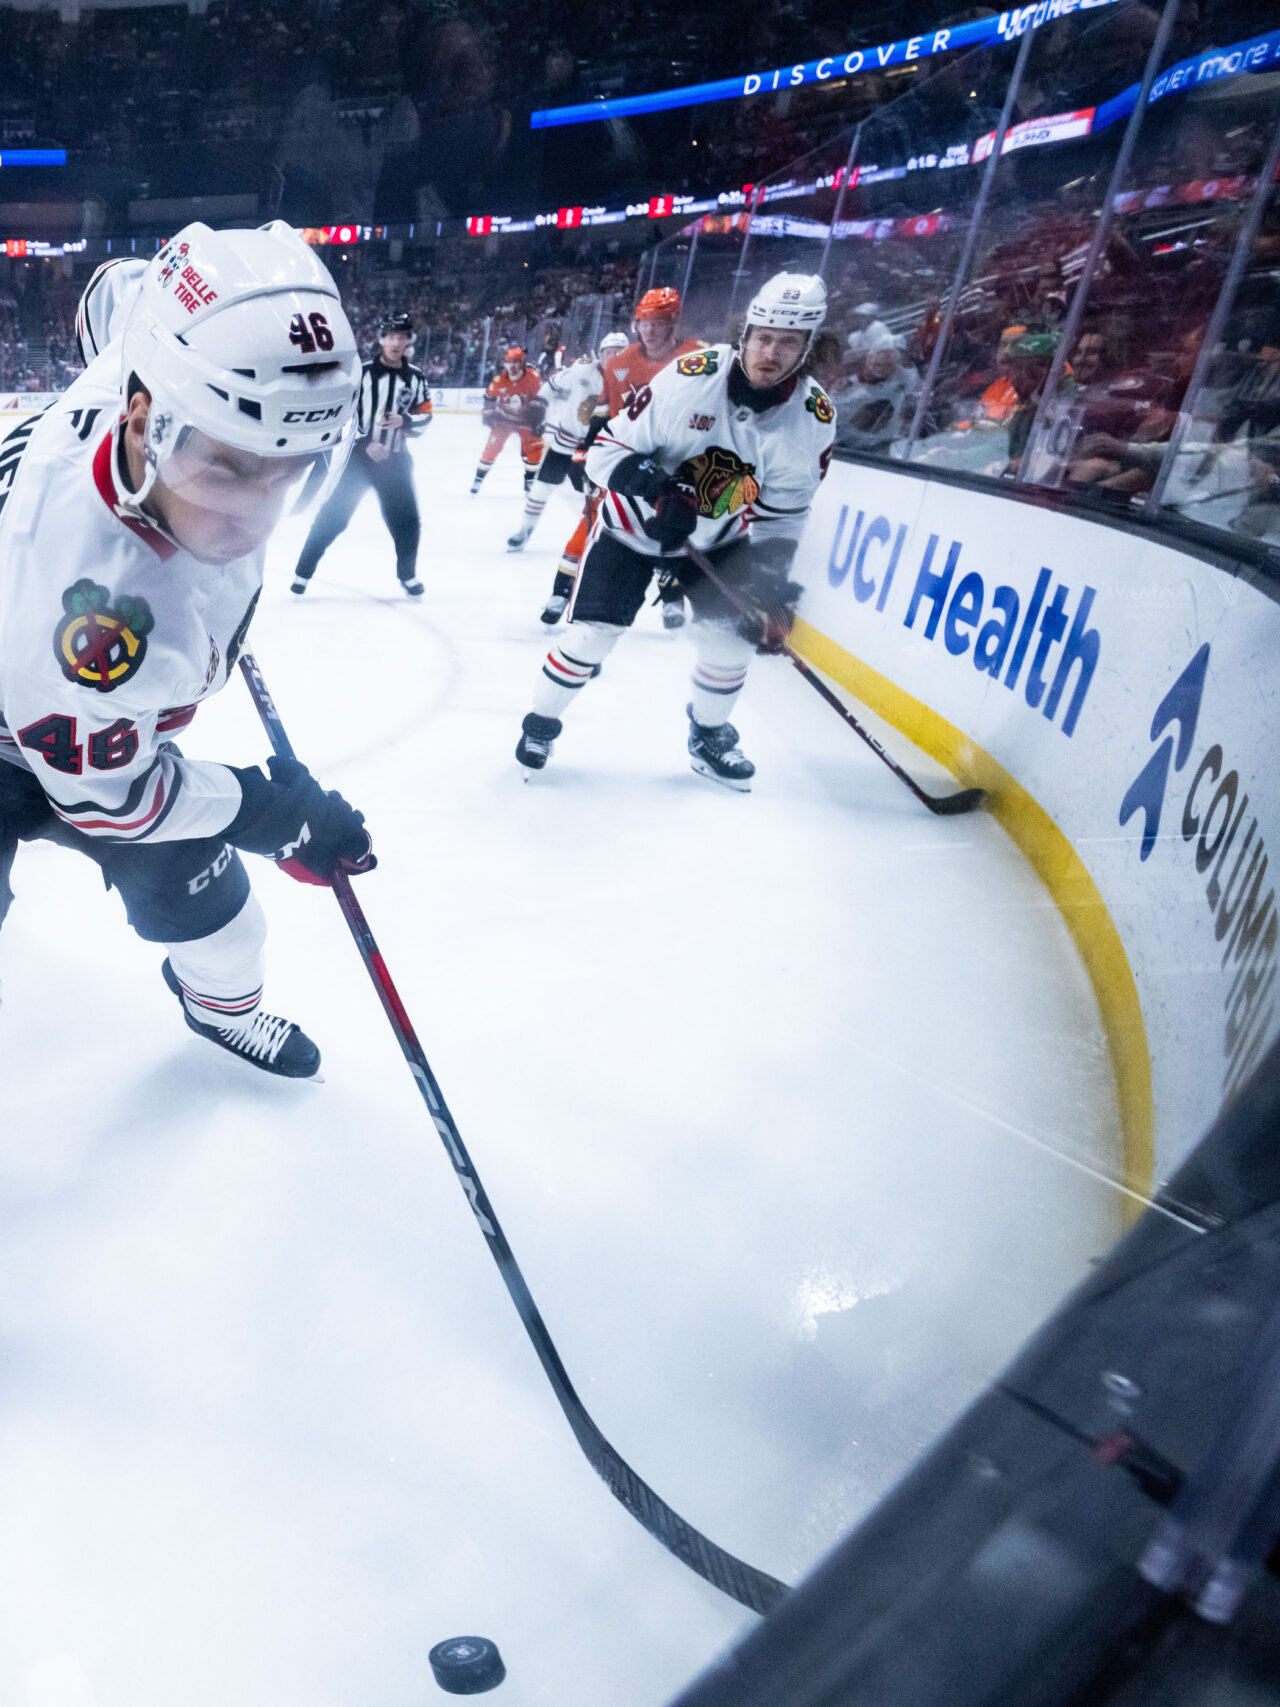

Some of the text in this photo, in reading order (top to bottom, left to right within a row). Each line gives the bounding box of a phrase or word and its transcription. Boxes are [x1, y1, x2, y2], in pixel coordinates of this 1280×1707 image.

[743, 29, 951, 95] DISCOVER
[1198, 43, 1268, 80] more
[173, 282, 201, 315] TIRE
[181, 265, 218, 306] BELLE
[288, 312, 335, 354] 46
[282, 404, 344, 423] CCM
[827, 505, 1101, 739] UCI Health
[17, 713, 140, 776] 46
